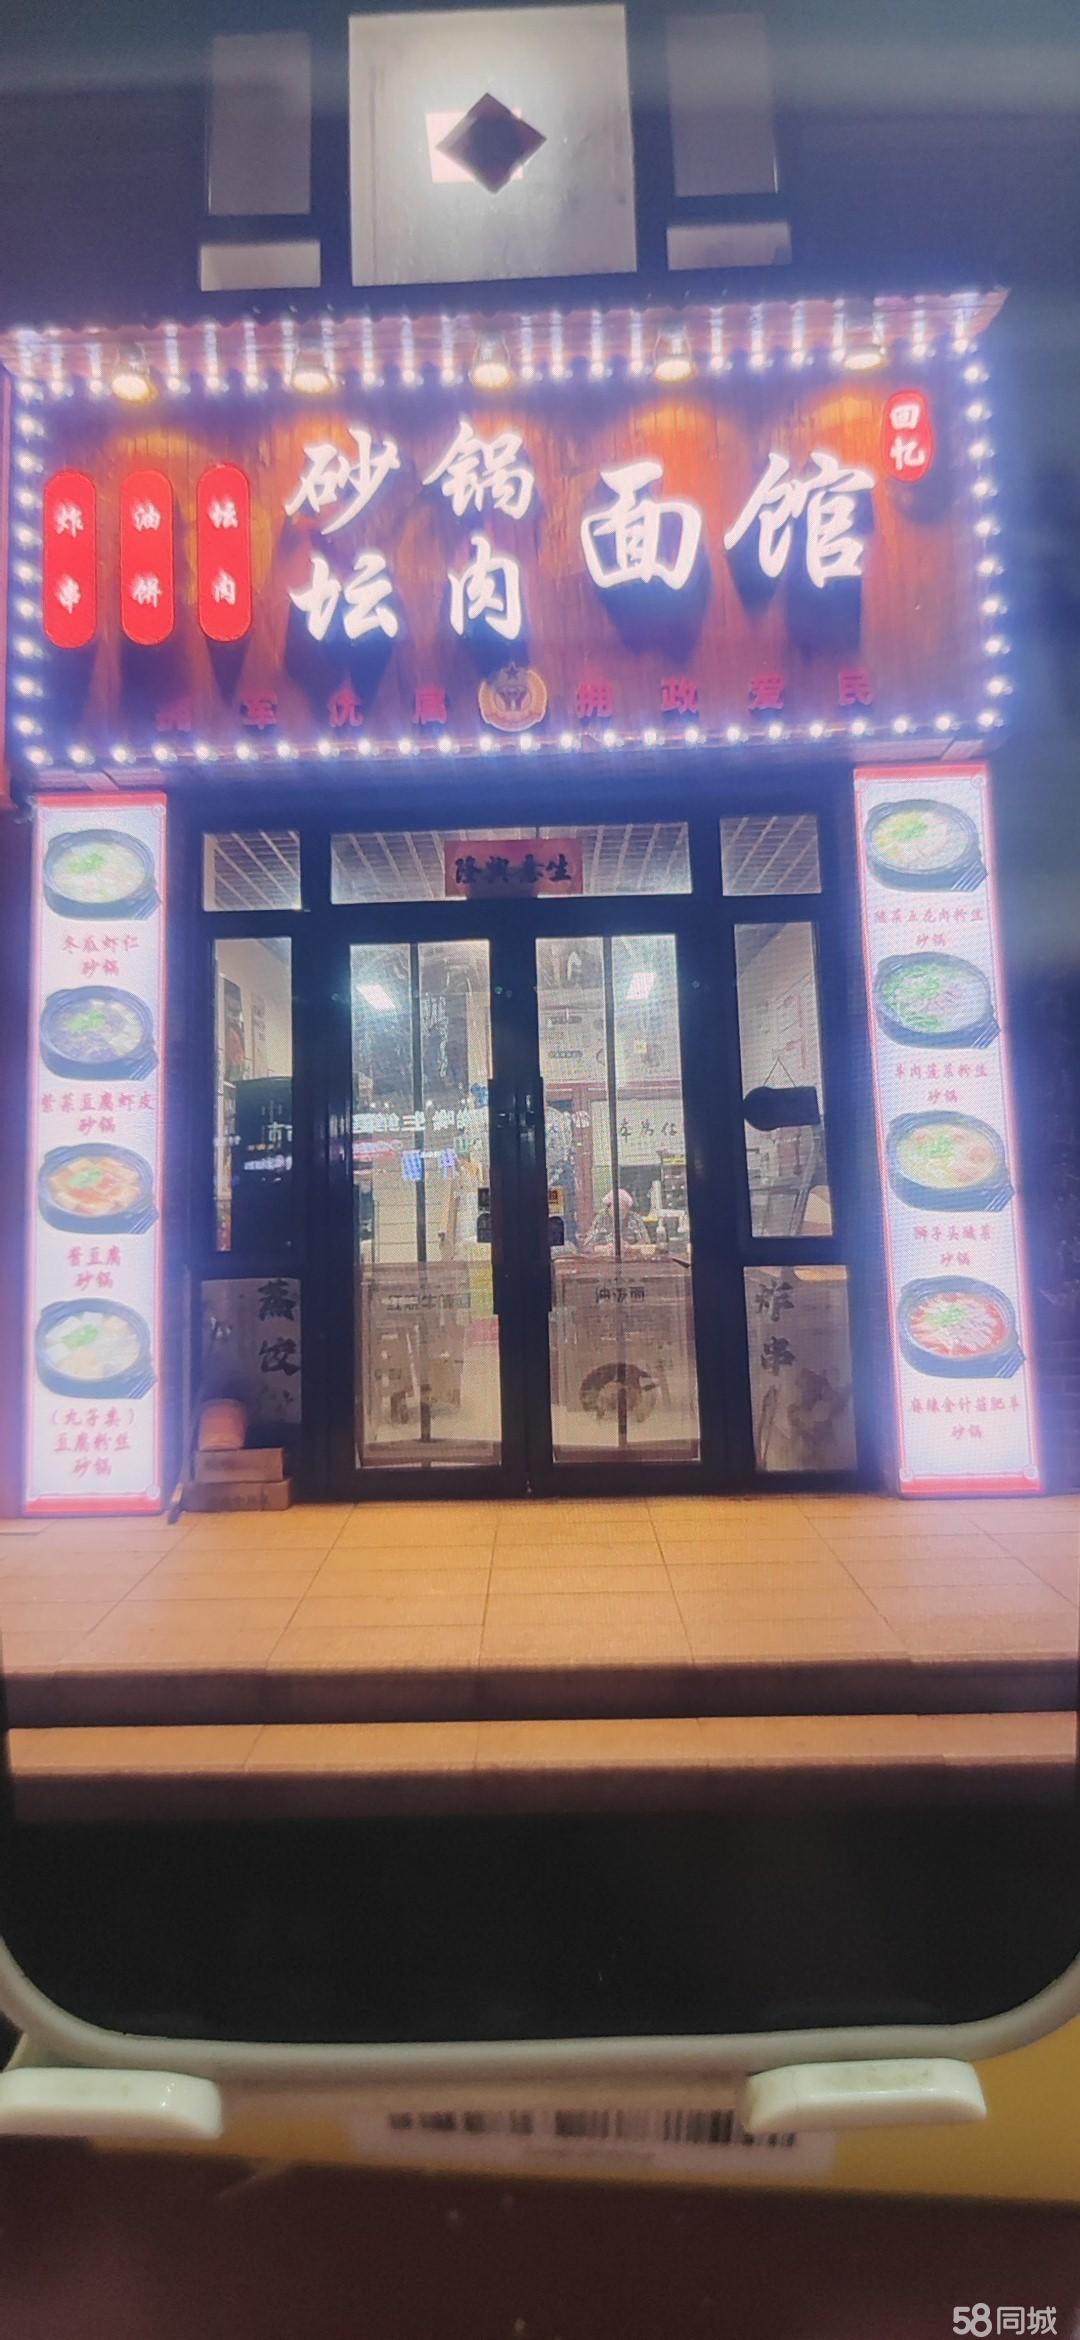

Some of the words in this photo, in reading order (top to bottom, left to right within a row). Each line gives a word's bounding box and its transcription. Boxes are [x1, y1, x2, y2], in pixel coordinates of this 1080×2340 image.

[888, 404, 925, 469] 回忆
[284, 416, 536, 535] 砂锅
[581, 451, 875, 590] 面馆
[55, 503, 84, 613] 炸串
[131, 502, 163, 608] 油饼
[208, 499, 238, 605] 坛肉
[289, 535, 523, 641] 坛肉
[576, 671, 874, 718] 拥政爱民
[62, 935, 140, 954] 冬瓜虾仁
[915, 932, 947, 949] 砂锅
[81, 958, 120, 977] 砂锅
[40, 1092, 155, 1113] 紫菜豆腐虾皮
[927, 1089, 958, 1105] 砂锅
[78, 1116, 116, 1136] 砂锅
[939, 1251, 971, 1268] 砂锅
[74, 1271, 114, 1292] 砂锅
[951, 1423, 982, 1441] 砂锅
[54, 1434, 132, 1453] 豆腐粉丝
[72, 1457, 113, 1478] 砂锅
